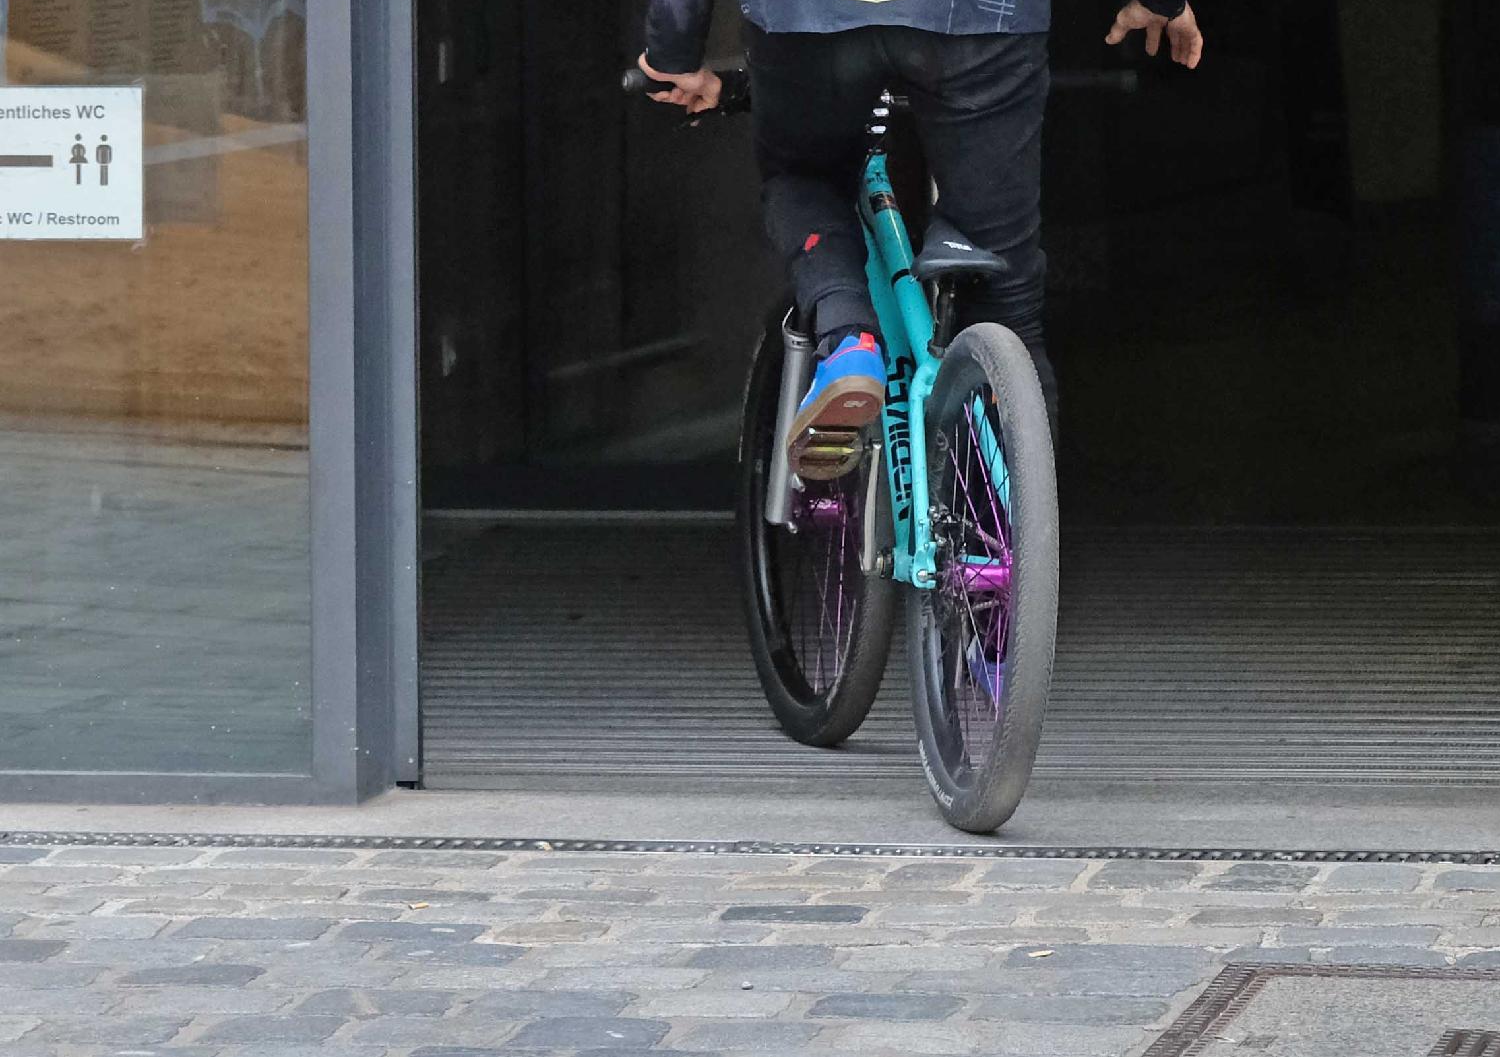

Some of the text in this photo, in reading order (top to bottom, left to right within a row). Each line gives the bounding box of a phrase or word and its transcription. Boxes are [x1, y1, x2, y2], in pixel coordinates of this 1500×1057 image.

[76, 104, 105, 120] WC
[7, 212, 34, 226] WC
[46, 212, 120, 226] Restroom
